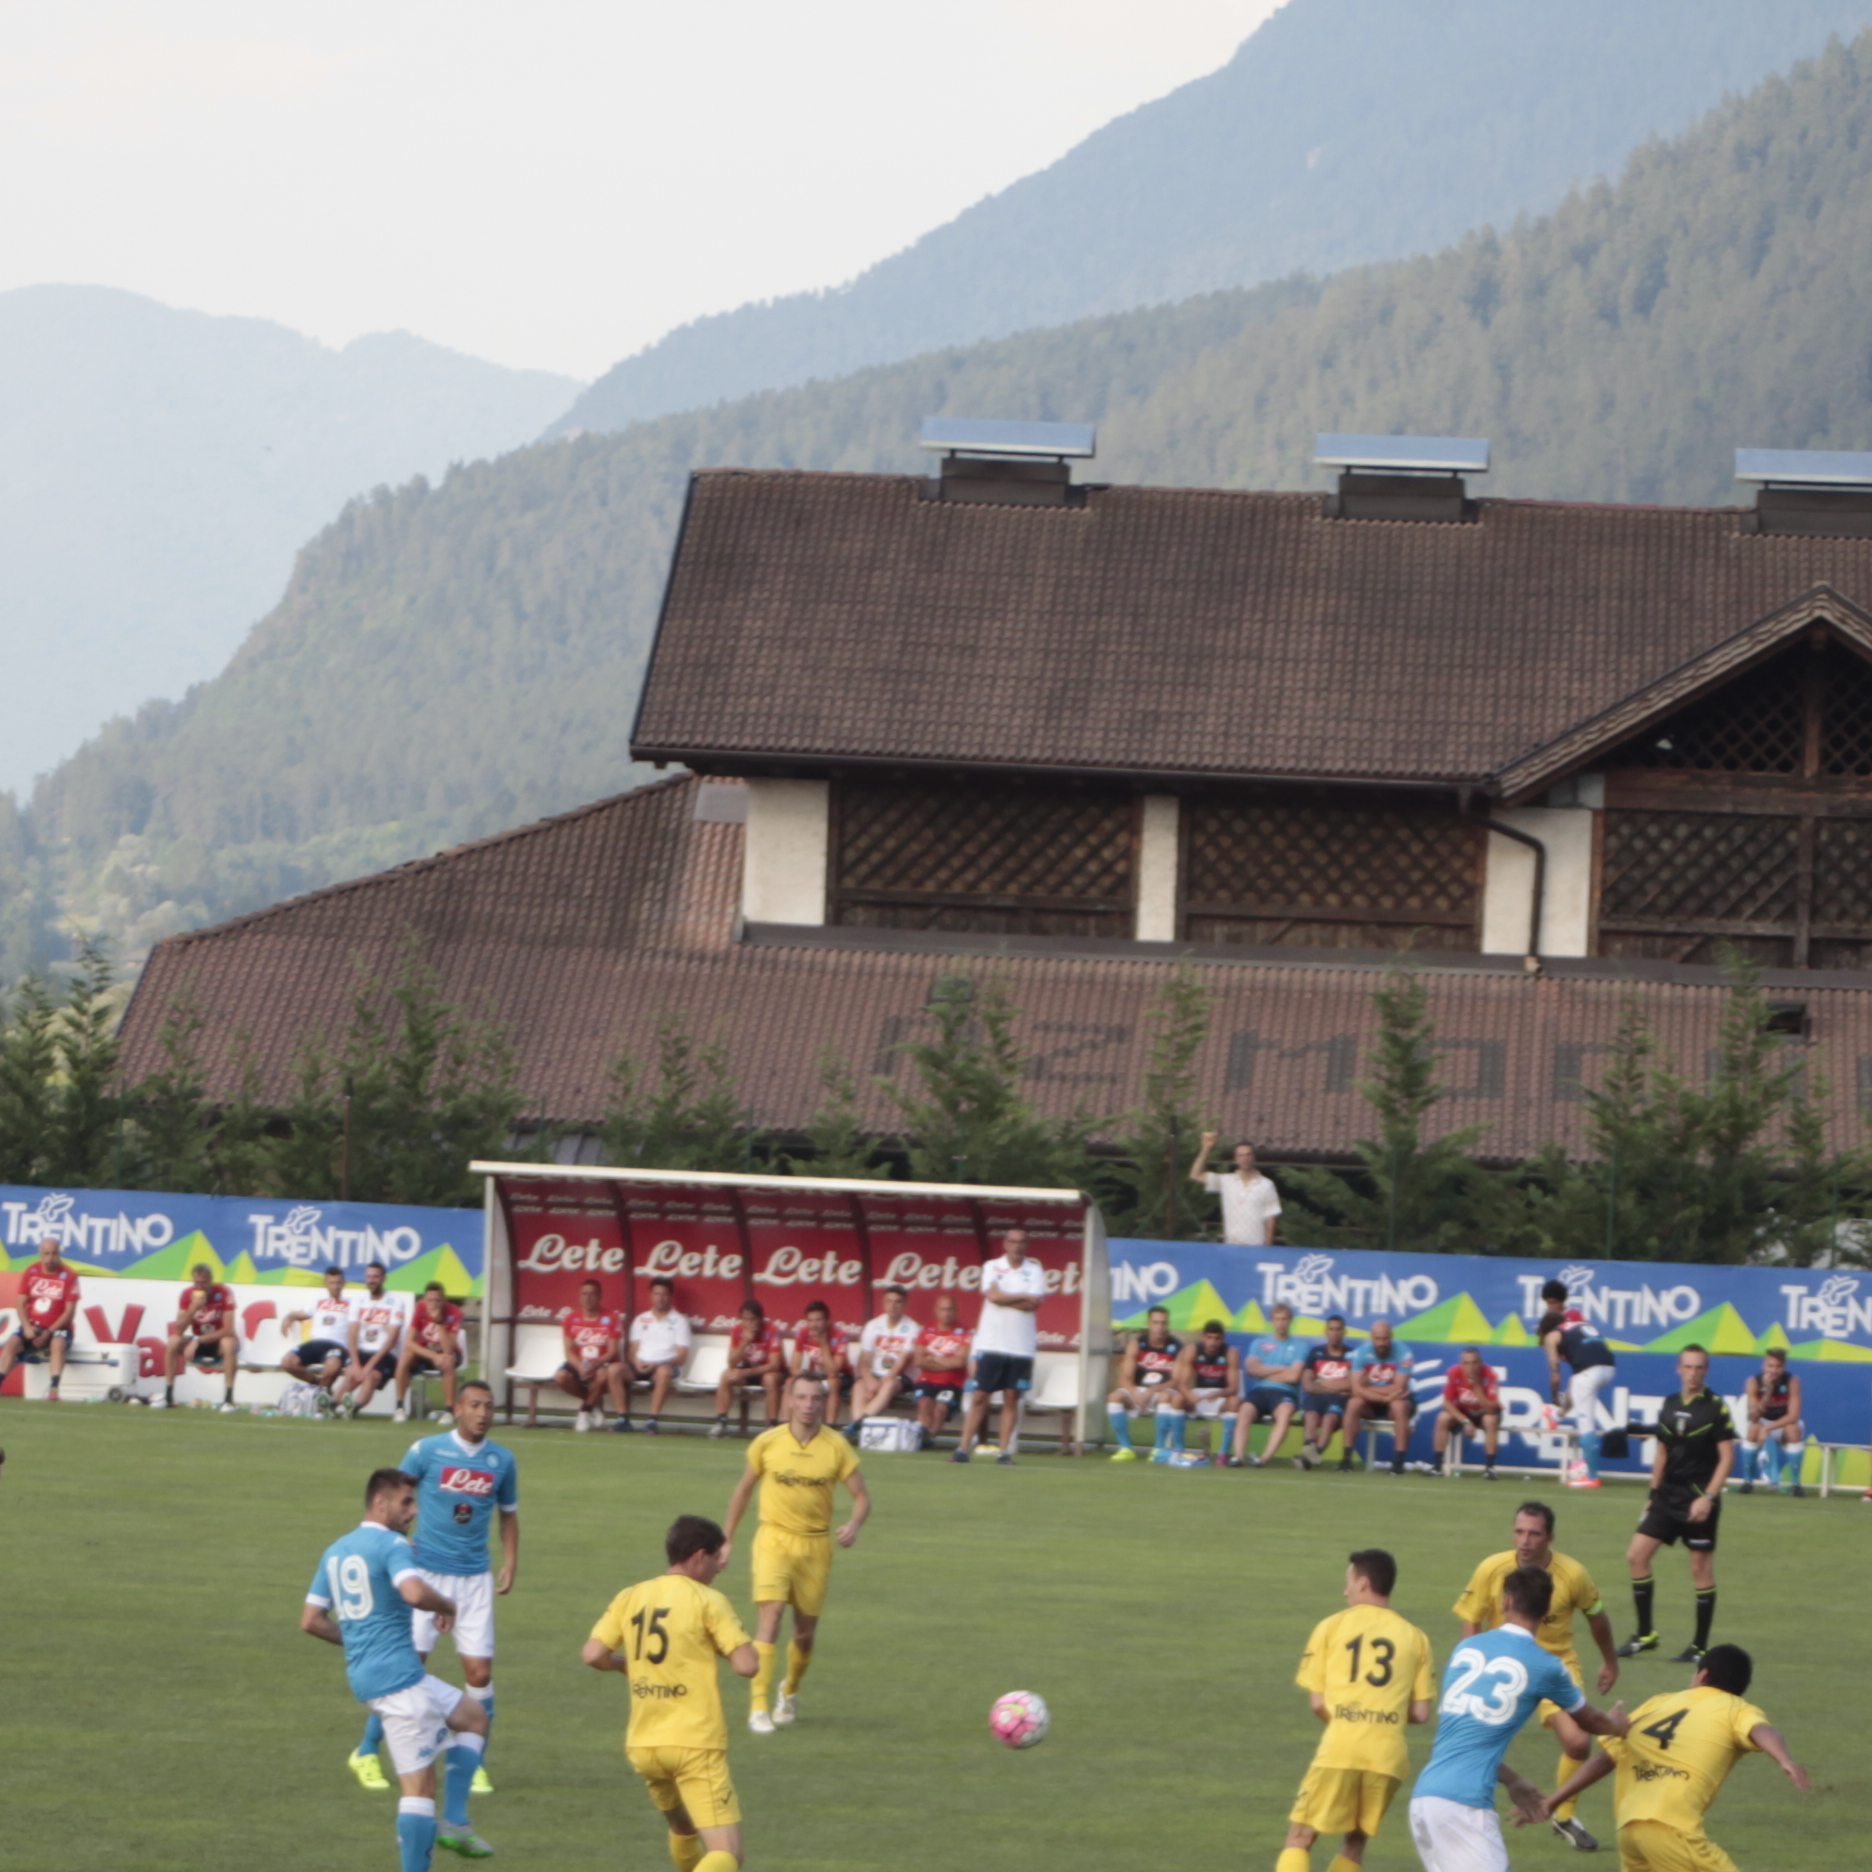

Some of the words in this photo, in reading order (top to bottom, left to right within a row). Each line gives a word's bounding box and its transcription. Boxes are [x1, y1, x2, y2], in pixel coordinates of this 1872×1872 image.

[1, 1201, 174, 1256] TRENTINO
[248, 1214, 422, 1268] TRENTINO
[517, 1234, 626, 1273] Lete
[633, 1240, 743, 1279] Lete
[752, 1246, 863, 1287] Lete
[871, 1252, 983, 1291] Lete
[1256, 1263, 1440, 1317] TRENTINO
[440, 1468, 494, 1494] Lete
[327, 1554, 374, 1621] 19
[631, 1605, 672, 1665] 15
[1345, 1634, 1396, 1687] 13
[1438, 1647, 1528, 1725] 23
[1335, 1703, 1399, 1725] TRENTINO
[1642, 1708, 1691, 1750] 4
